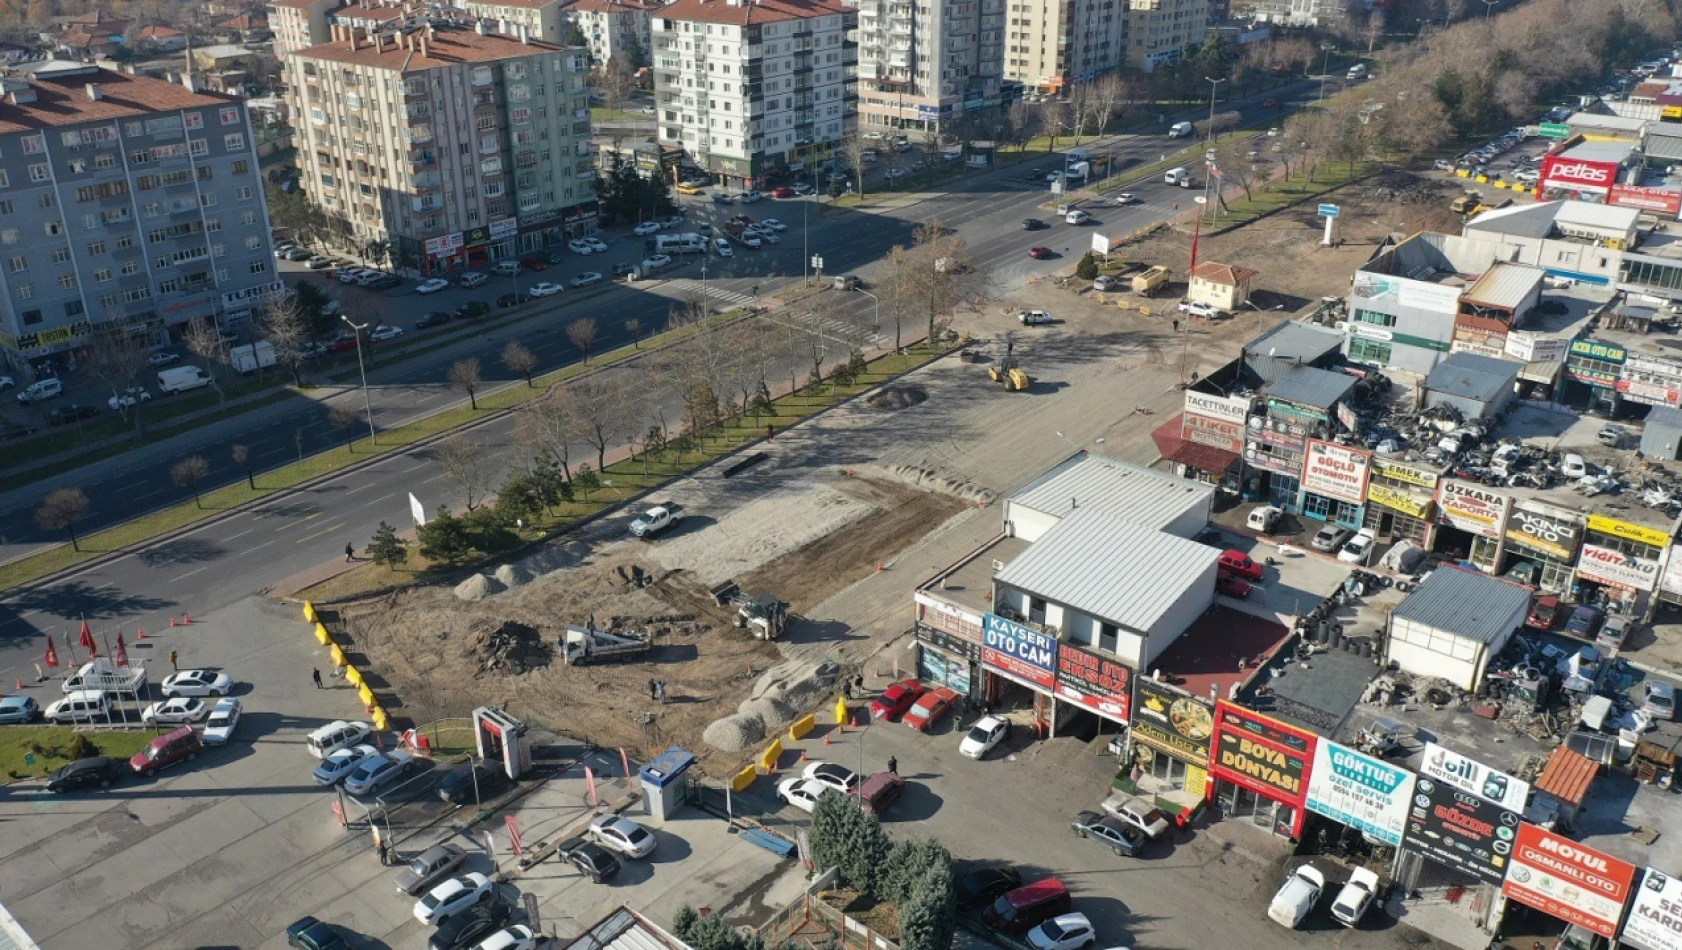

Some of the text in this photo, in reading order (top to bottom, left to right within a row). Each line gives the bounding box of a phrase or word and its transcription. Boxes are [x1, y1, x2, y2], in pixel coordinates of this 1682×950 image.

[1549, 163, 1607, 182] petlas
[226, 282, 281, 302] TURBO
[1591, 345, 1607, 357] OTO
[1607, 348, 1624, 360] CAM
[1317, 456, 1355, 472] GÜÇLÜ
[1388, 464, 1421, 479] EMEK
[1445, 480, 1503, 506] ÖZKARA
[1442, 498, 1499, 520] KAPORTA
[1512, 512, 1575, 538] AKINCI
[1522, 523, 1559, 542] OTO
[987, 630, 1015, 653] OTO
[1019, 642, 1052, 667] CAM
[1102, 661, 1128, 682] OTO
[1136, 722, 1166, 741] Adem
[1169, 735, 1194, 752] Usta
[1240, 738, 1287, 769] BOYA
[1222, 750, 1300, 793] DÜNYASI
[1333, 751, 1397, 787] GÖKTUĞ
[1428, 765, 1475, 791] MOTOR OIL
[1433, 804, 1495, 838] GÖZDE
[1538, 837, 1608, 873] MOTUL
[1524, 850, 1615, 892] OSMANLI OTO
